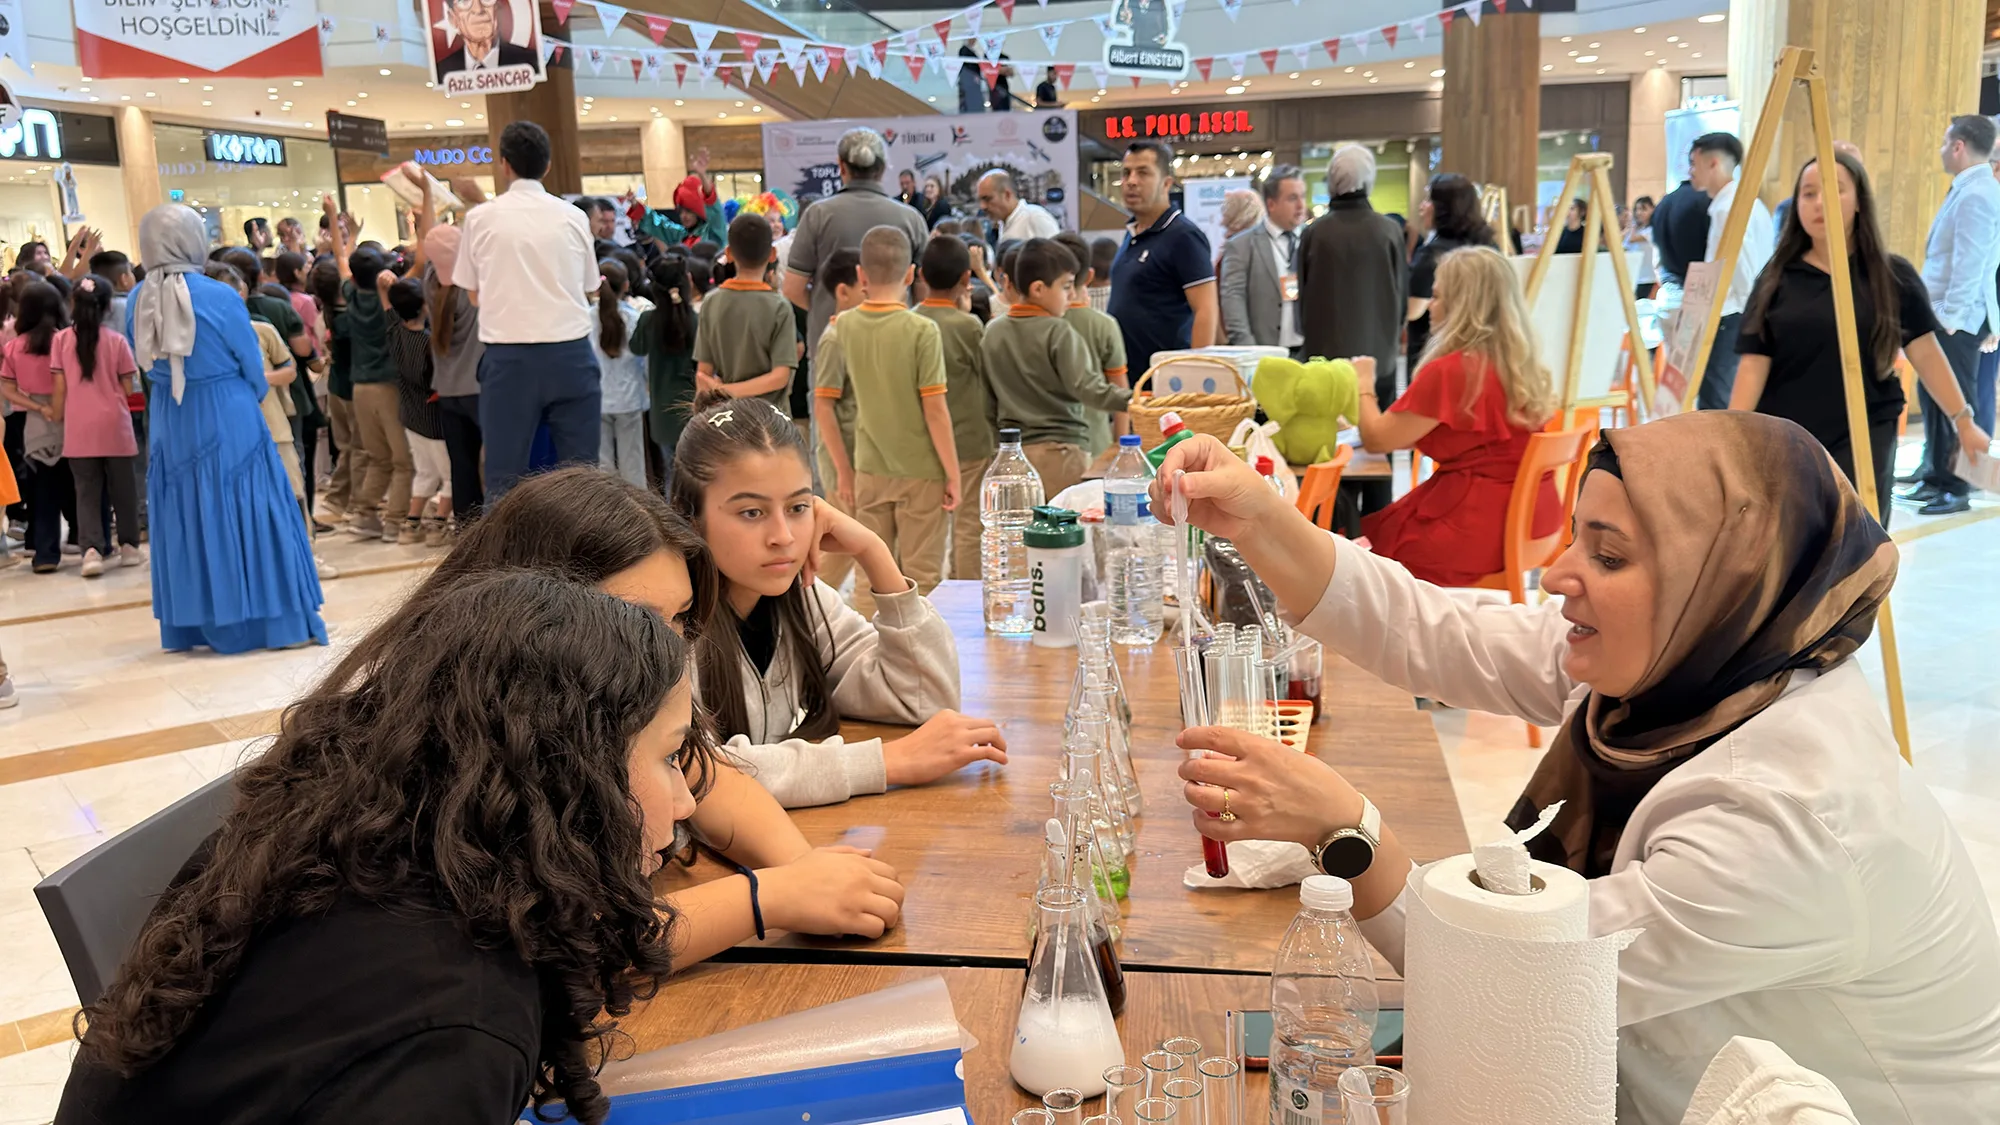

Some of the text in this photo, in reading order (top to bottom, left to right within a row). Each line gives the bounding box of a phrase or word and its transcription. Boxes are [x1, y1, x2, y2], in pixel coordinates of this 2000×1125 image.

[120, 14, 280, 40] HOŞGELDİNİ
[1111, 49, 1183, 68] Albert EINSTEIN
[448, 70, 532, 93] Aziz SANCAR
[1105, 110, 1254, 138] U.S. POLO ASSN.
[212, 133, 283, 164] KOTON
[414, 148, 466, 165] MUDO
